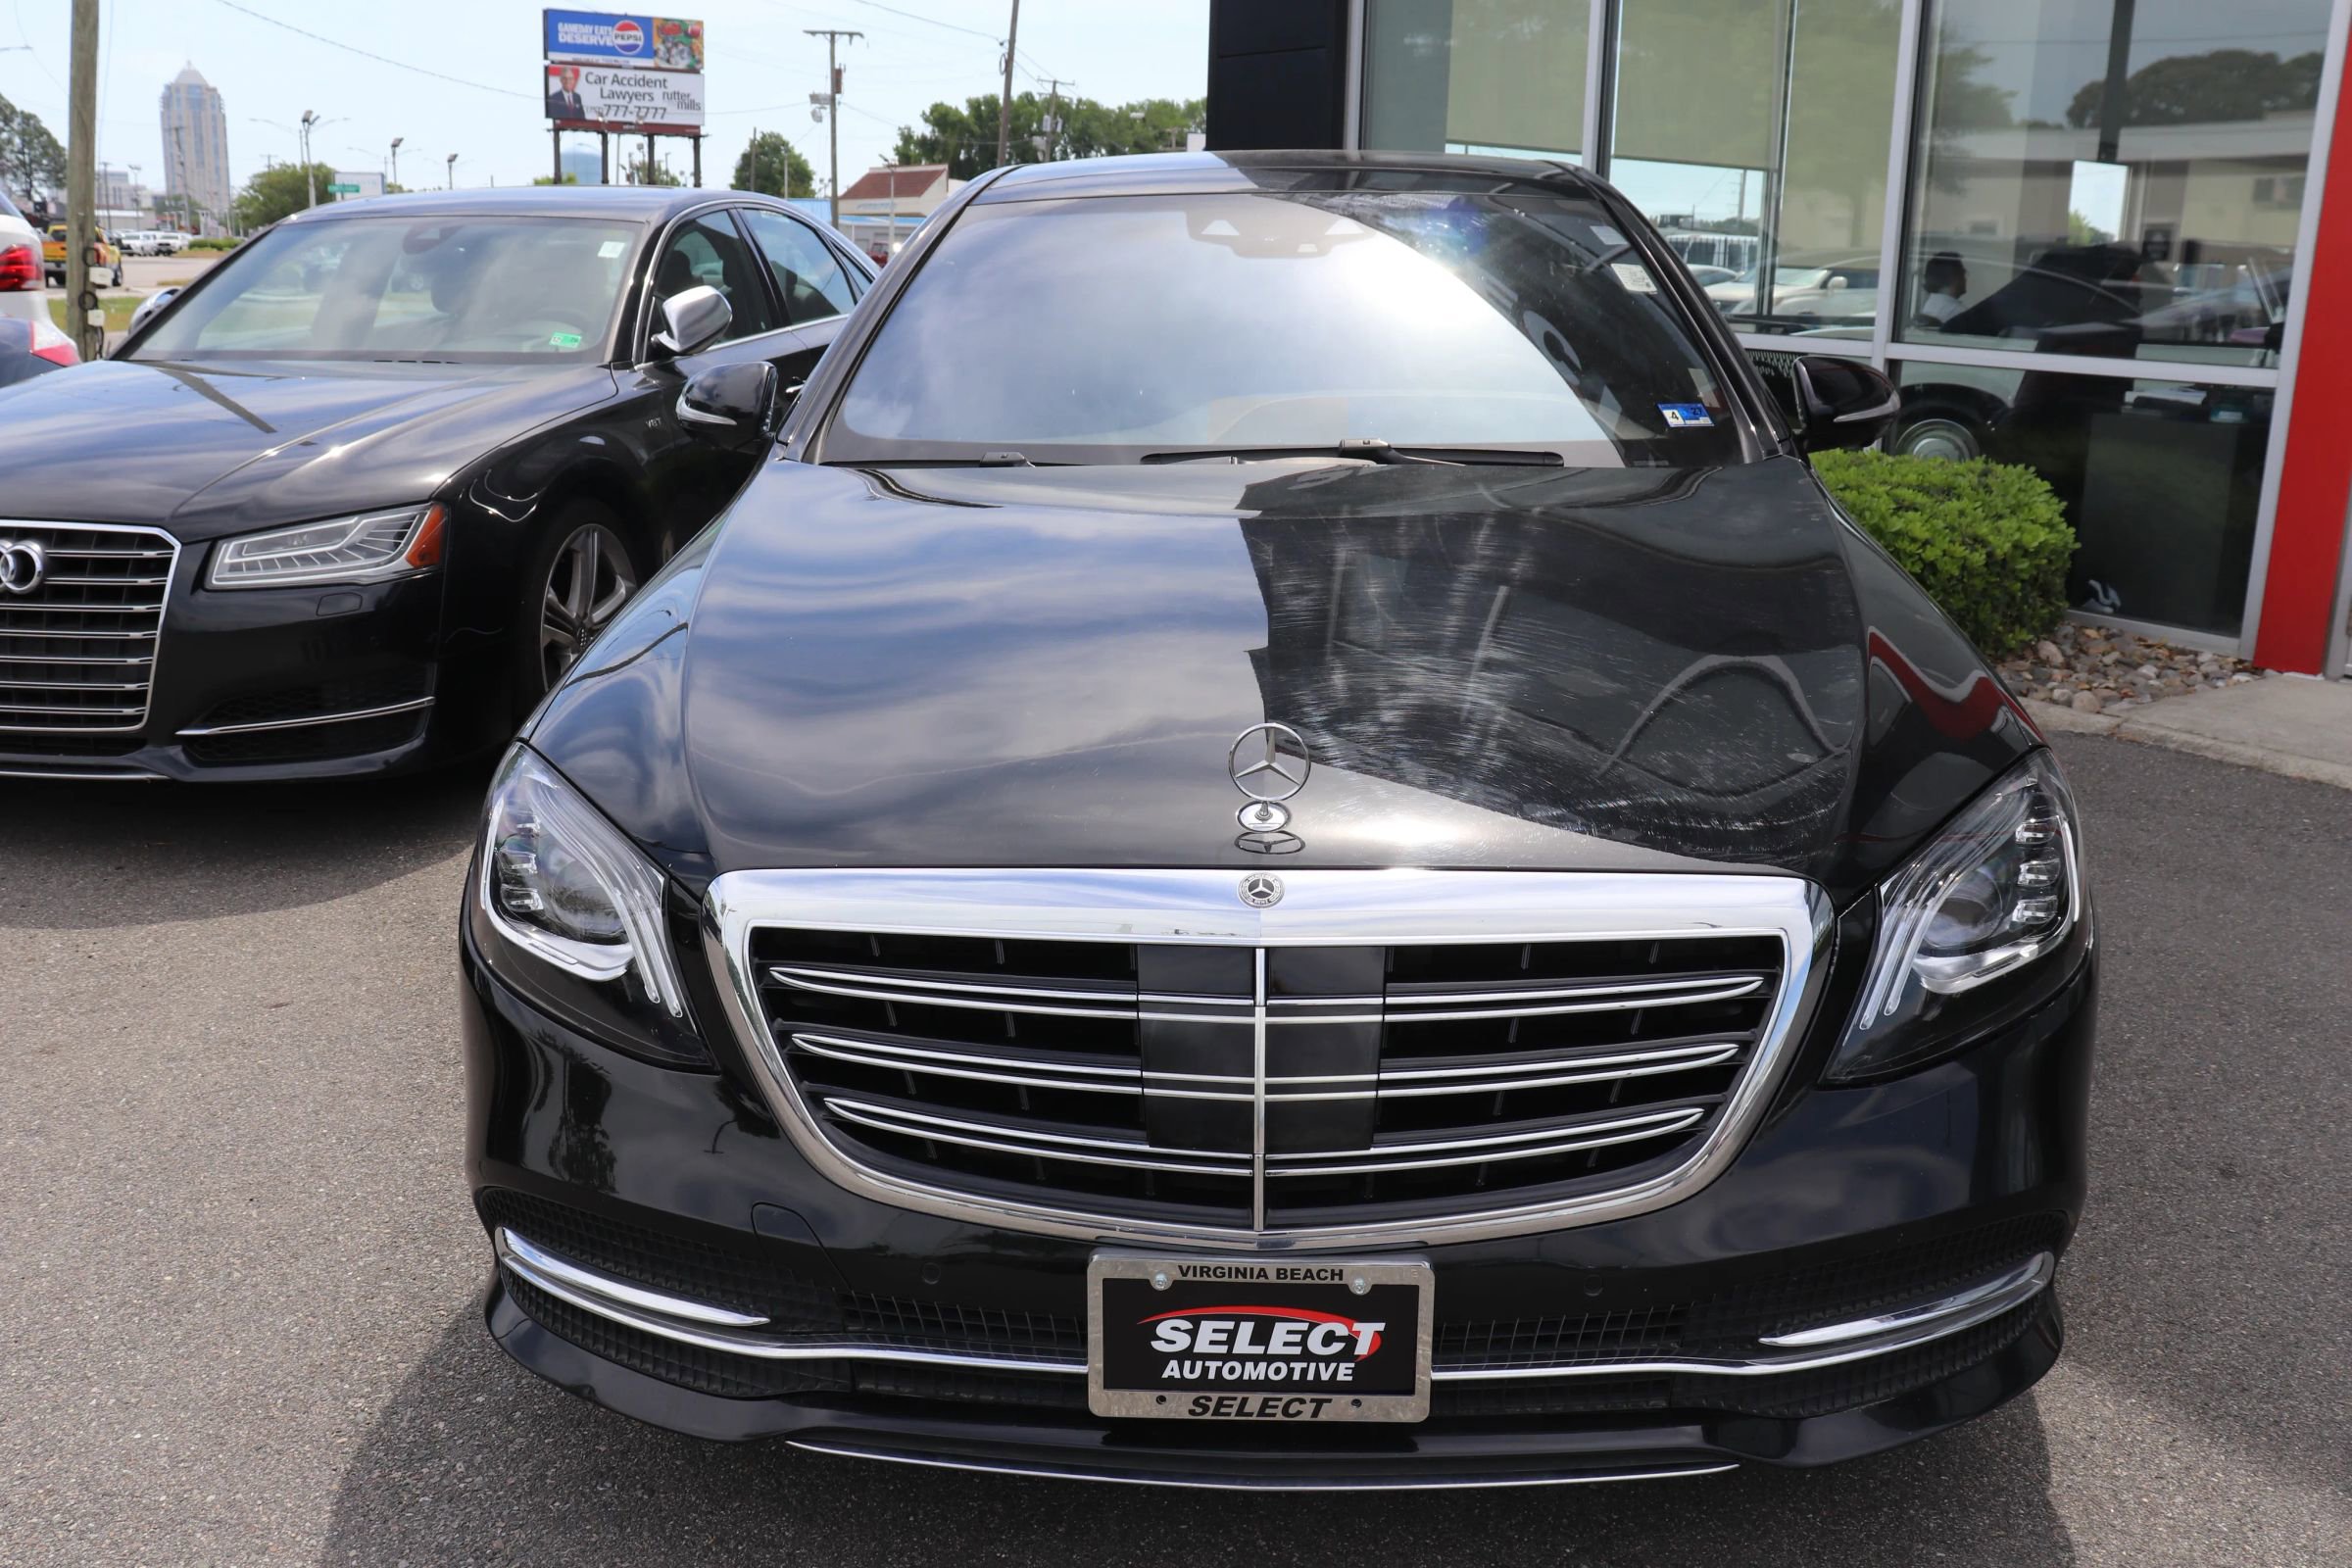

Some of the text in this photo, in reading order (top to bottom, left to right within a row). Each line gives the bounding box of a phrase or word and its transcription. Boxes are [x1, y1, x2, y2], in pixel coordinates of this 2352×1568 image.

[558, 32, 613, 47] DESERVE
[613, 32, 642, 42] PEPSI
[584, 72, 668, 89] Car Accident
[600, 87, 655, 103] Lawyers
[662, 90, 691, 101] rutter
[677, 99, 702, 111] mills
[1177, 1265, 1344, 1282] VIRGINIA BEACH
[1150, 1318, 1386, 1356] SELECT
[1161, 1359, 1355, 1381] AUTOMOTIVE
[1188, 1396, 1333, 1419] SELECT
